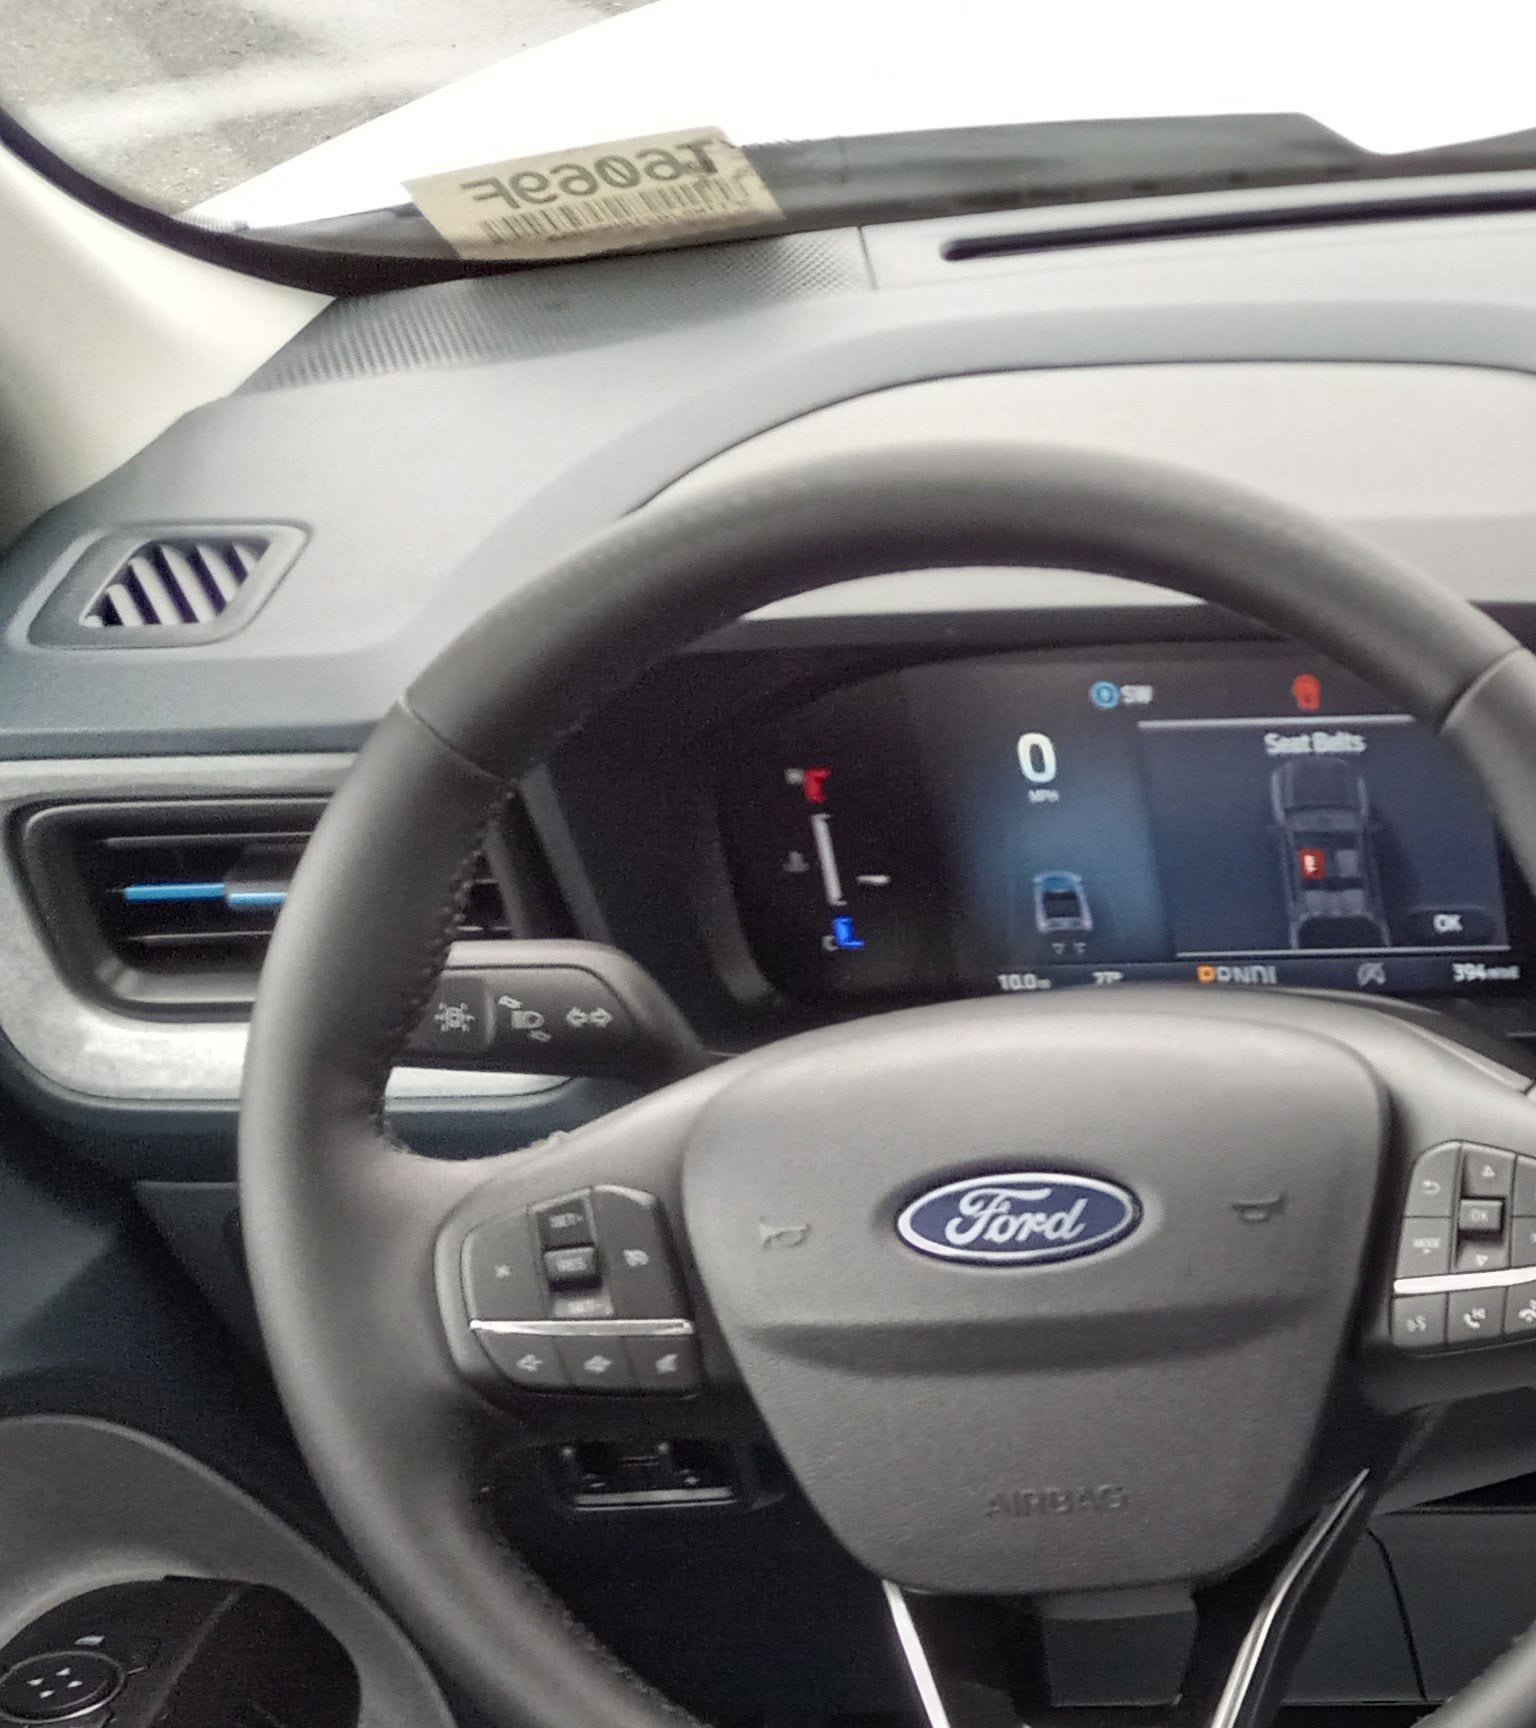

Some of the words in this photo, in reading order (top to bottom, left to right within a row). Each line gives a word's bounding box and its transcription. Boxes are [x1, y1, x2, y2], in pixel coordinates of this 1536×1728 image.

[1017, 732, 1057, 783] 0
[1433, 912, 1463, 934] OK
[944, 1187, 1089, 1245] Ford
[1470, 1210, 1489, 1223] OK
[985, 1483, 1129, 1518] AIRBAG
